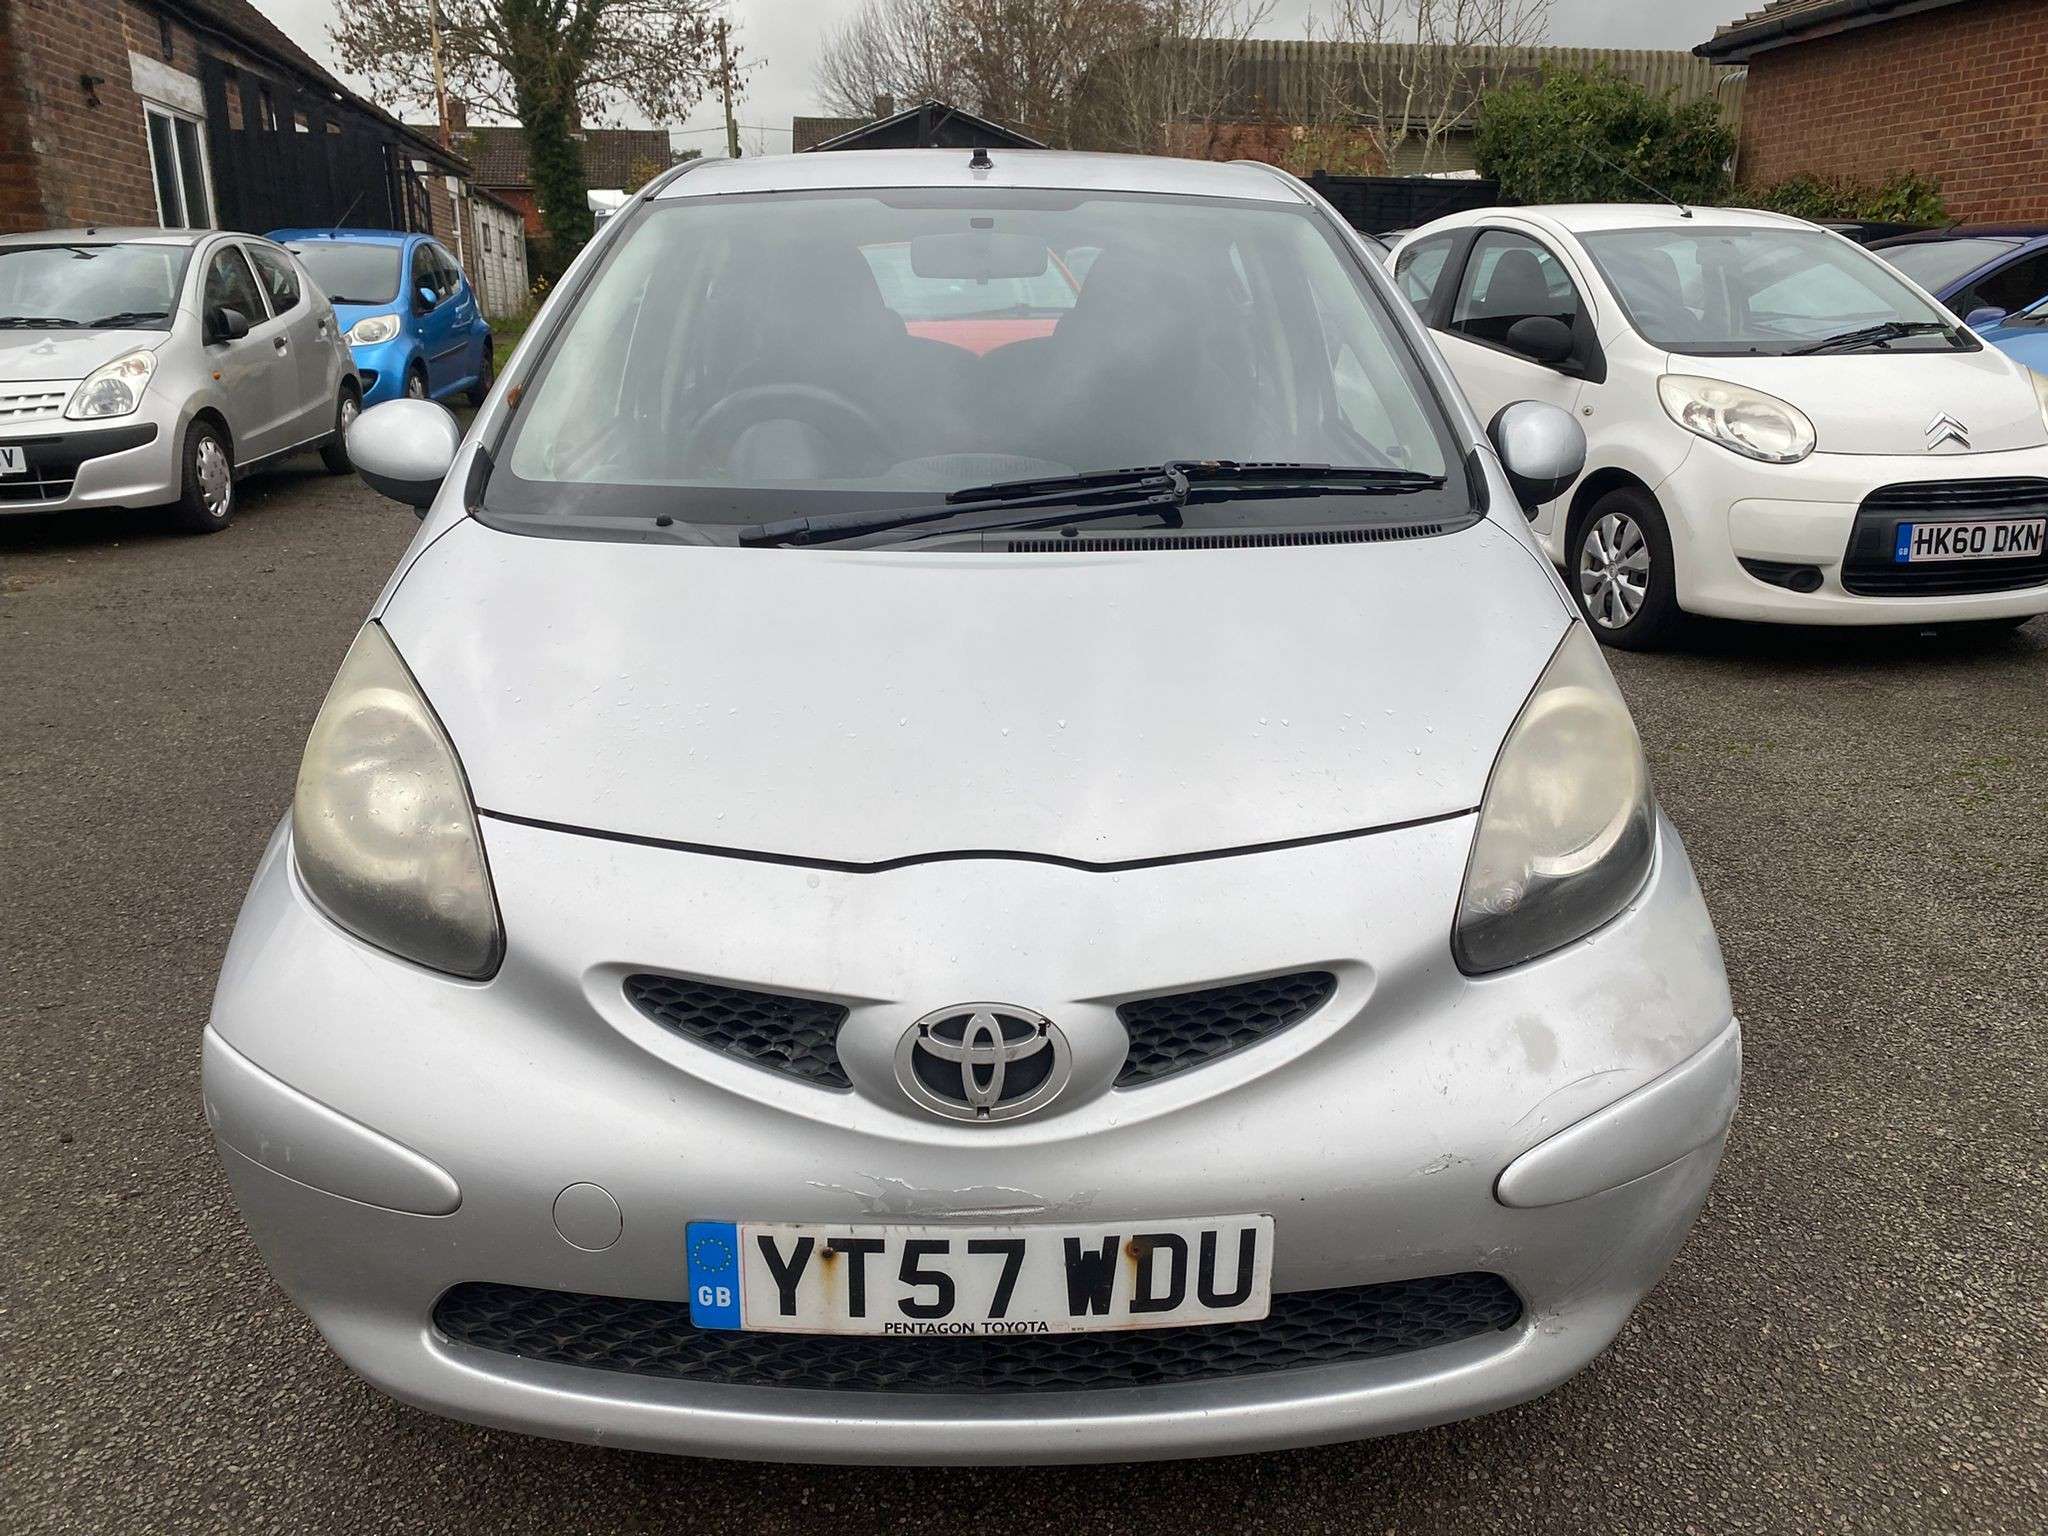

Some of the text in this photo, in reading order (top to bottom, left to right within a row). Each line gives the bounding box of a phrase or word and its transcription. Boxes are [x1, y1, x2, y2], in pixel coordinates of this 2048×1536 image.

[0, 448, 13, 468] V
[1916, 524, 2041, 555] HK60 DKN
[757, 1228, 1255, 1318] YT57 WDU
[698, 1286, 731, 1307] GB
[884, 1321, 1049, 1334] PENTAGON TOYOTA
